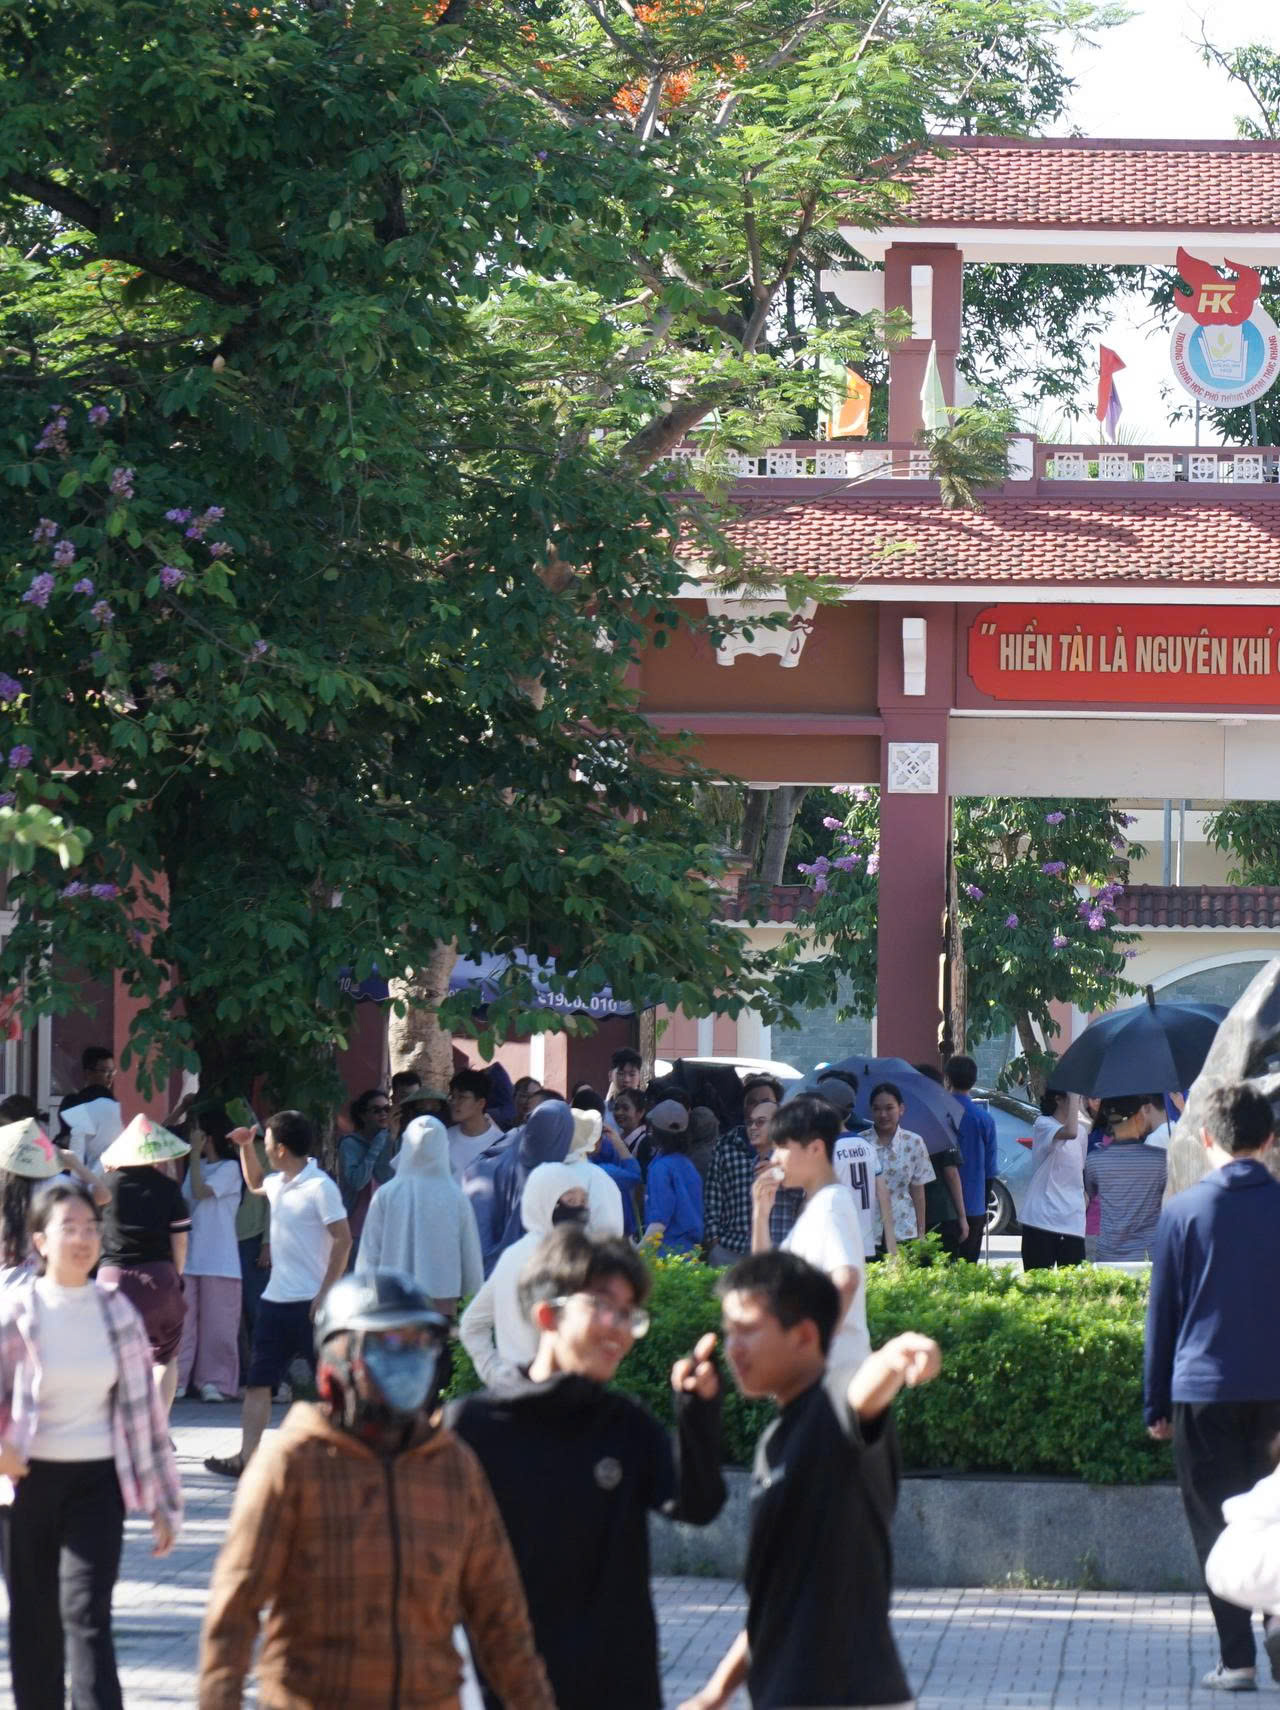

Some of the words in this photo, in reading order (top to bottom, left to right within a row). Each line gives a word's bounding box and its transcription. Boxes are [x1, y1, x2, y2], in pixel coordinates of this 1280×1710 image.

[1198, 293, 1235, 314] HK
[1059, 625, 1093, 672] TÀI
[1100, 625, 1128, 672] LÀ
[1136, 628, 1227, 674] NGUYÊN
[1232, 628, 1273, 675] KHÍ
[850, 1162, 870, 1209] 4
